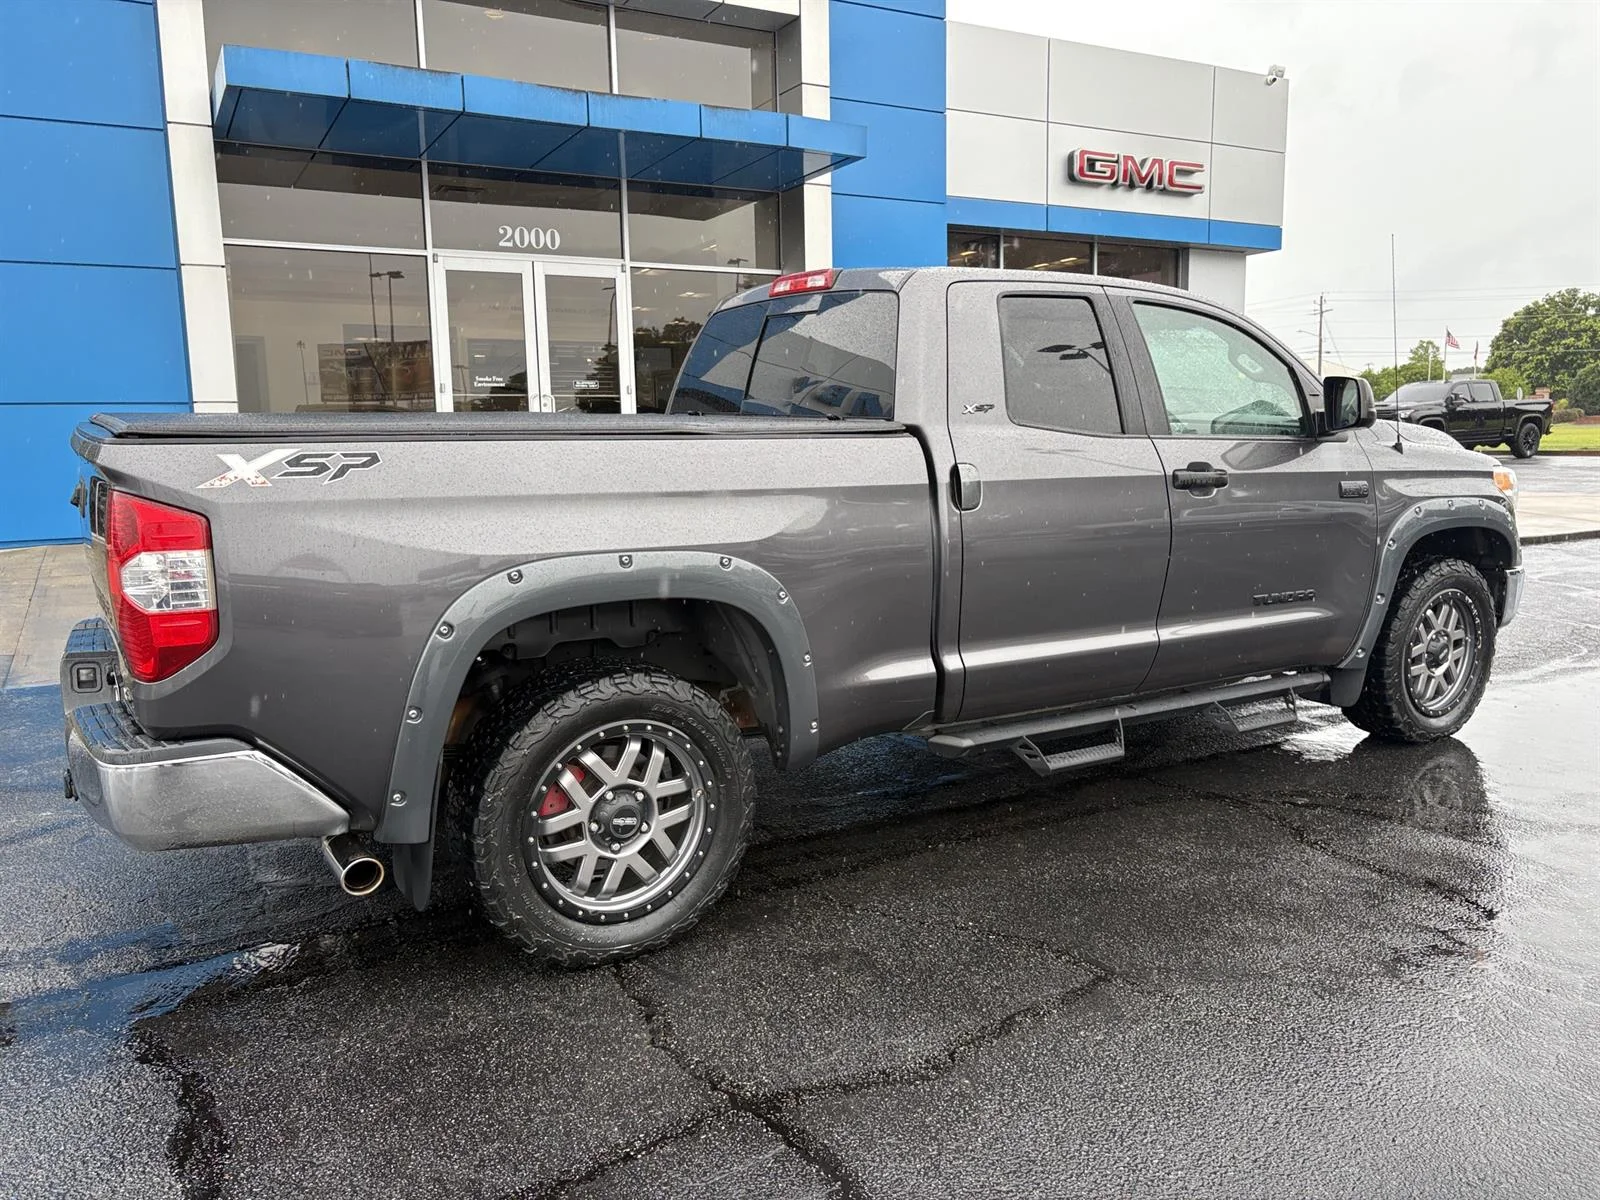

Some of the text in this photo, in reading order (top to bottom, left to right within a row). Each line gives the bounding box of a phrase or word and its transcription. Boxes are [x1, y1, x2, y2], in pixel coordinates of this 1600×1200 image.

[1071, 149, 1205, 195] GMC
[498, 225, 561, 250] 2000
[961, 403, 995, 414] XSP
[196, 448, 382, 489] XSP
[1253, 589, 1315, 606] TUNDRA
